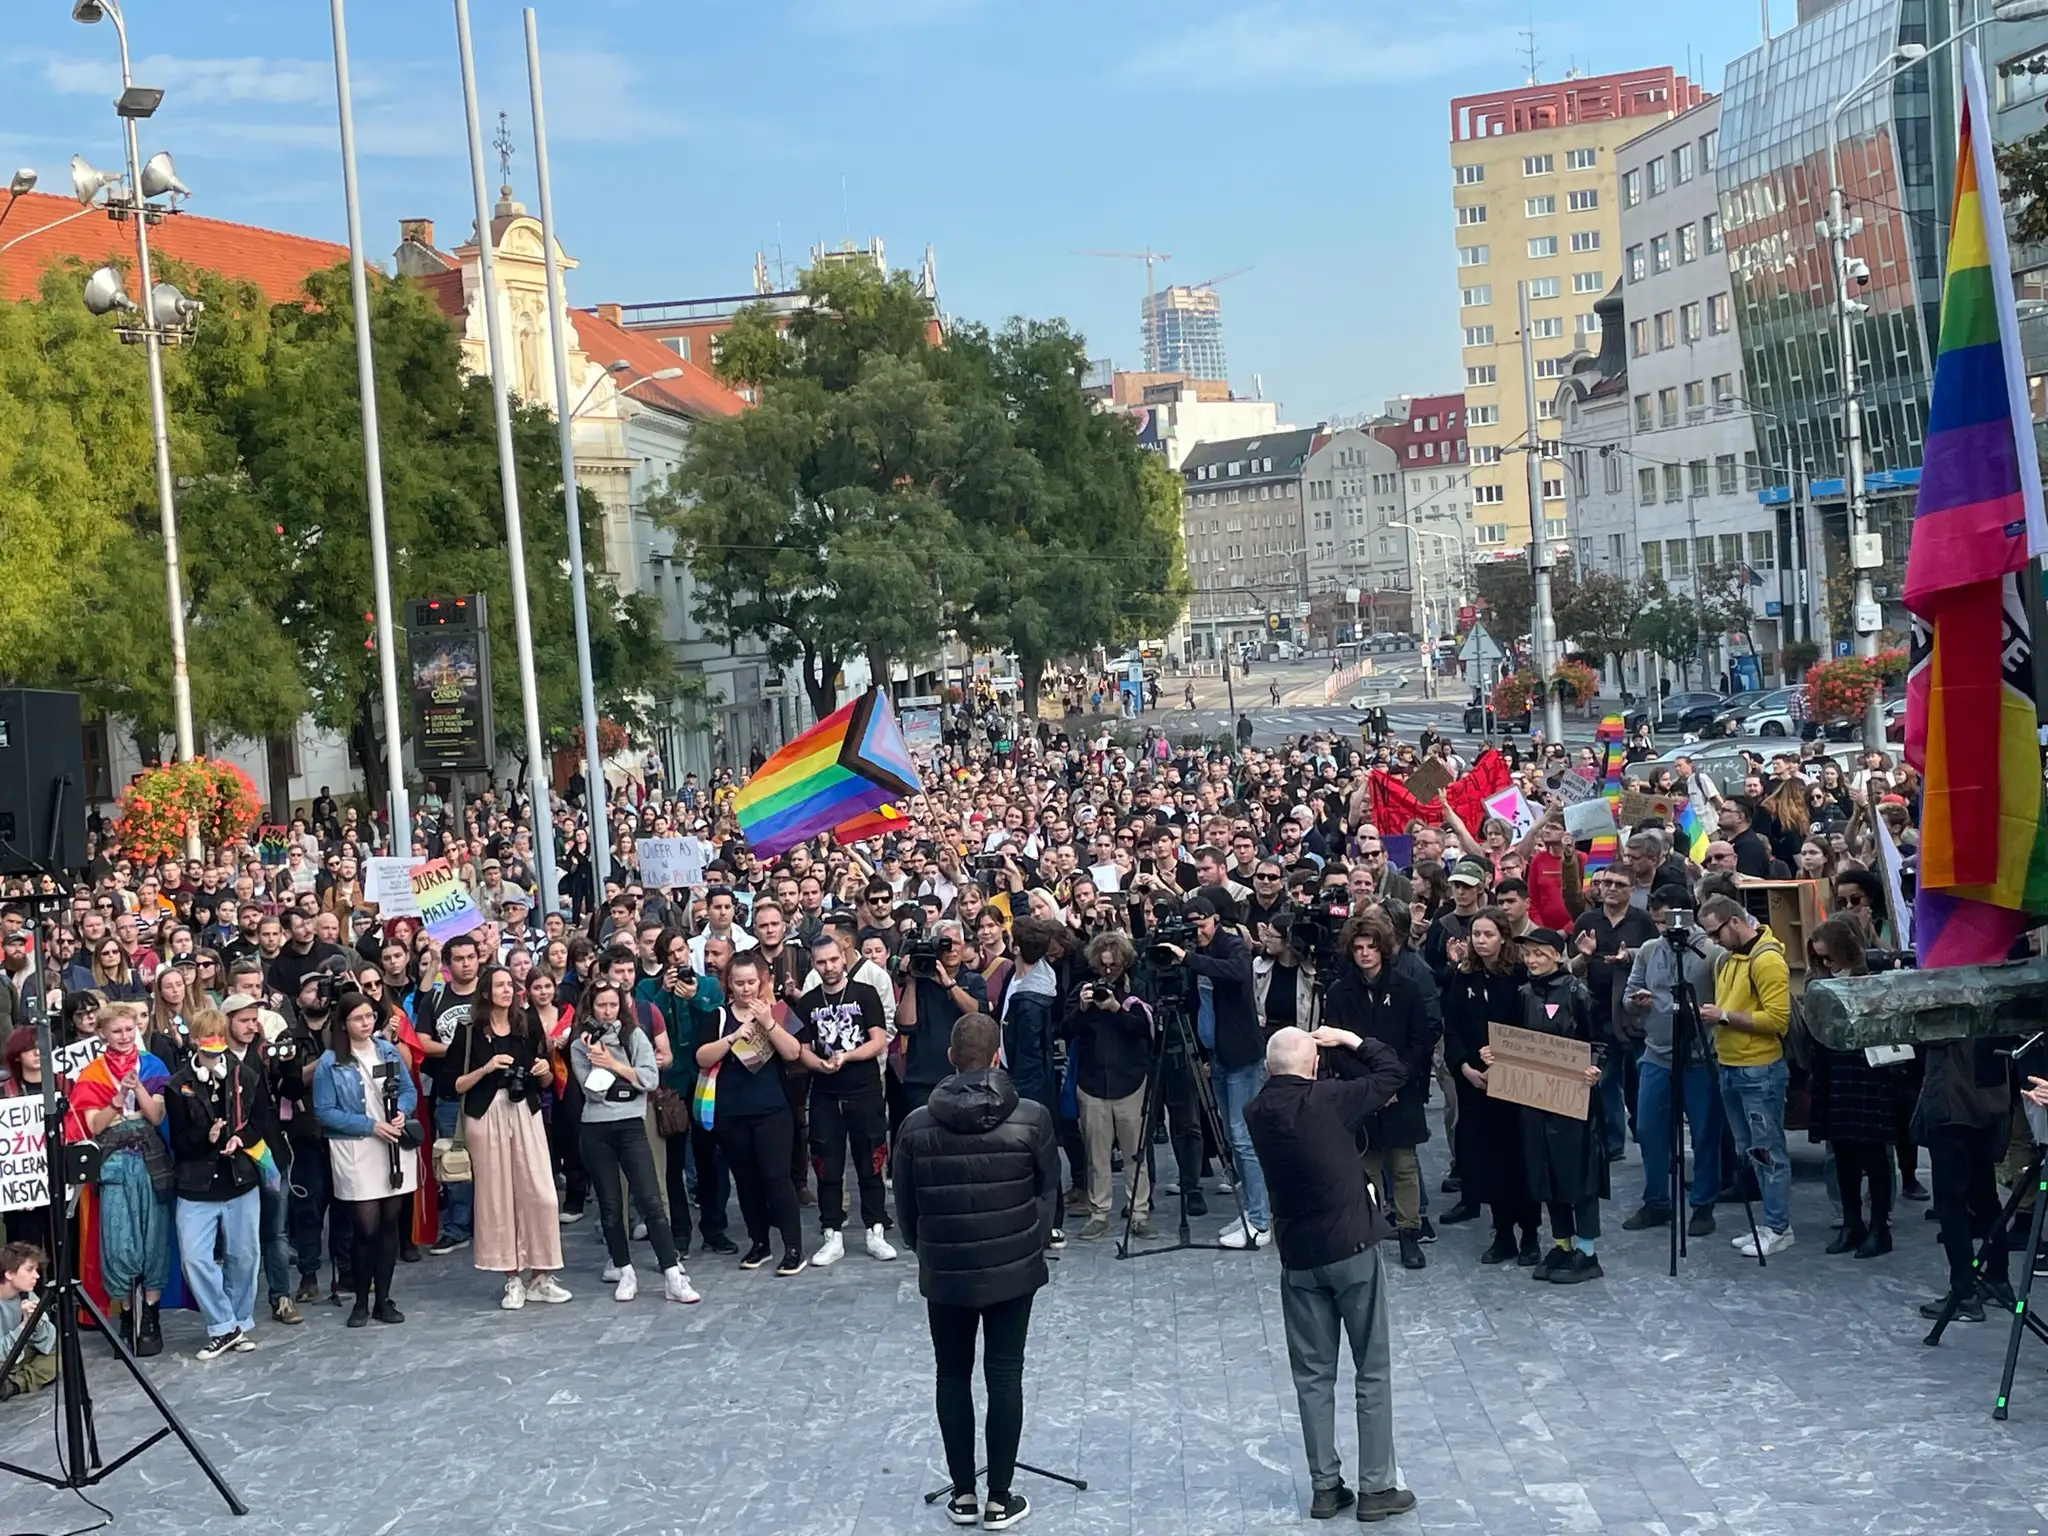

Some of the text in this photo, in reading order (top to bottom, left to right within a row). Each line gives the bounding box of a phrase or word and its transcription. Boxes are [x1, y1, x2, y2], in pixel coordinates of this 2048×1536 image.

[1840, 643, 1848, 656] P
[431, 689, 461, 699] CASINO
[643, 841, 674, 858] QUEER
[412, 866, 453, 894] JURAJ
[1495, 1065, 1534, 1100] JURAJ
[3, 1179, 49, 1206] NESTA
